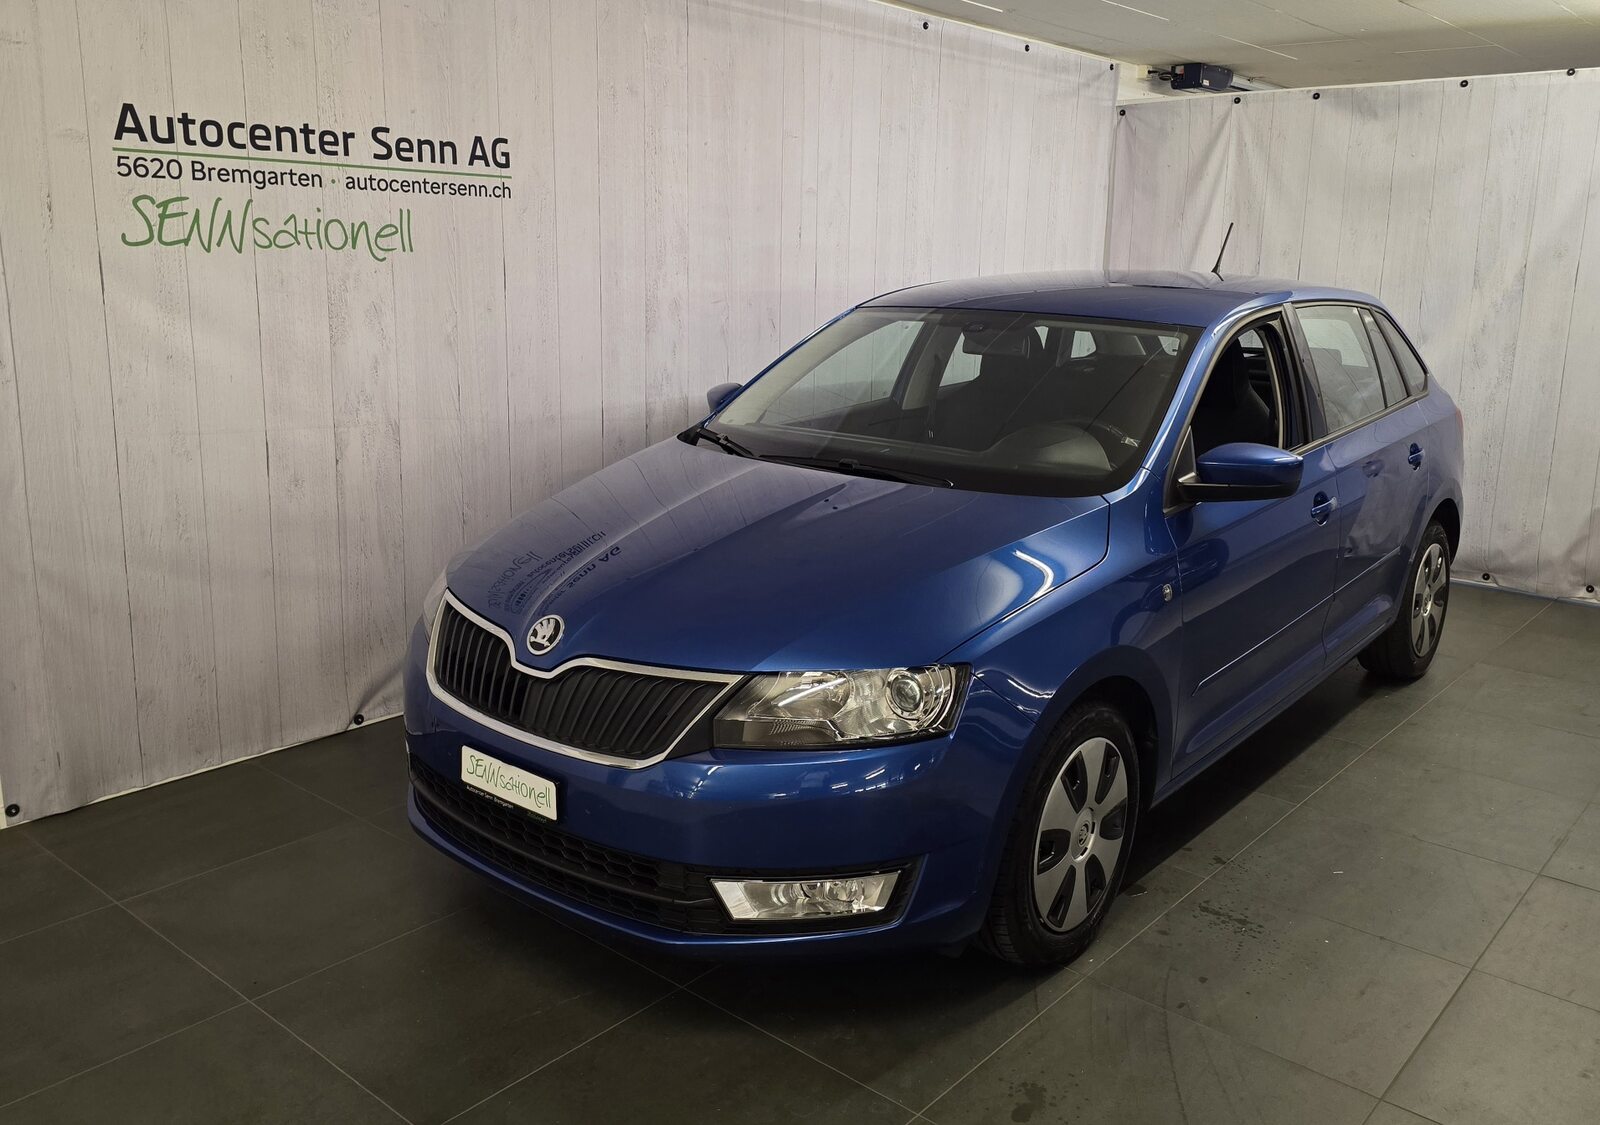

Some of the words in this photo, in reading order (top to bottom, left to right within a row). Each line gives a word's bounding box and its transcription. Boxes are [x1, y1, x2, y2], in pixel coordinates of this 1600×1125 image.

[113, 102, 356, 157] Autocenter
[371, 126, 458, 165] Senn
[467, 135, 512, 169] AG
[116, 155, 183, 181] 5620
[190, 160, 324, 190] Bremgarten
[344, 173, 512, 199] autocentersenn.ch
[120, 194, 414, 262] SENNsationell
[466, 754, 552, 809] SENNsationell
